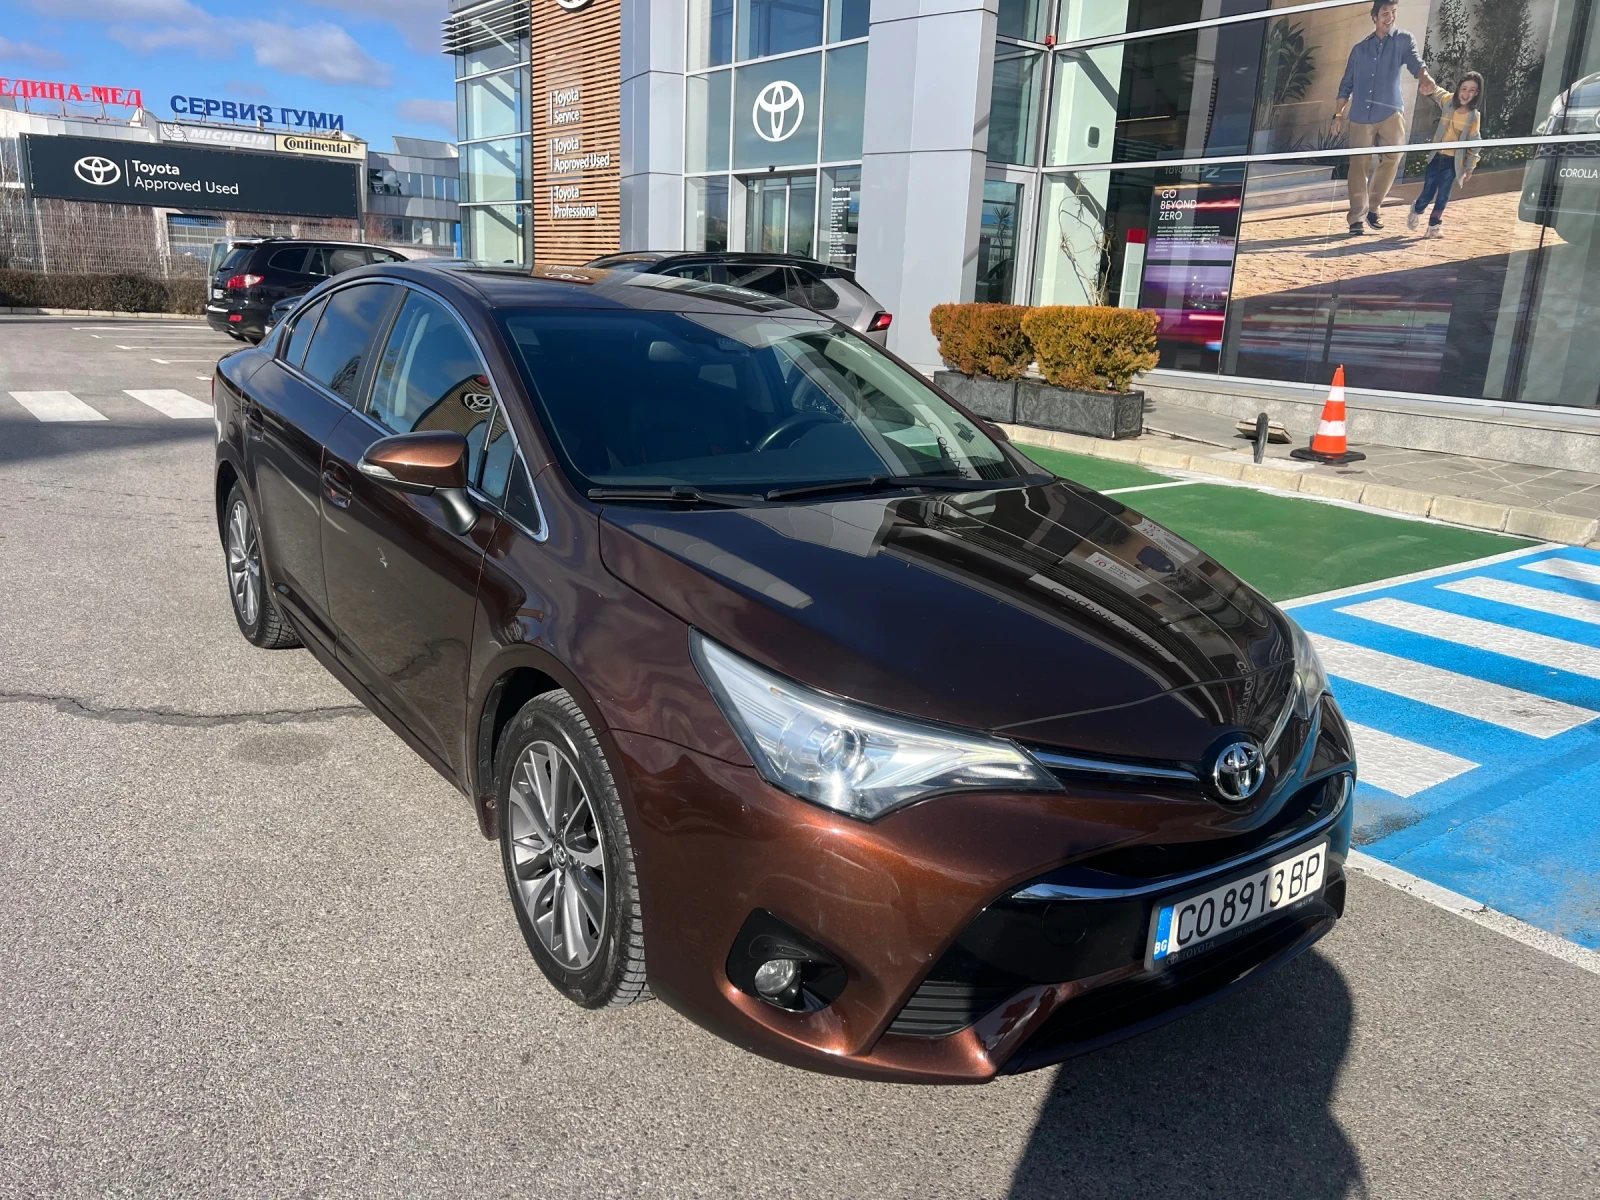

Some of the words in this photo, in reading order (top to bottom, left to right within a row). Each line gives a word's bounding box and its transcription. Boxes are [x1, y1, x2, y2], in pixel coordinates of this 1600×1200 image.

[555, 88, 579, 107] Toyota
[170, 95, 273, 123] СЕРВИЗ
[280, 107, 344, 130] ГУМИ
[554, 108, 580, 124] Service
[189, 128, 269, 146] MICHELIN
[283, 136, 352, 154] Continental
[555, 137, 579, 154] Toyota
[131, 160, 180, 176] Toyota
[555, 153, 590, 173] Approved
[590, 151, 610, 167] Used
[1560, 168, 1598, 178] COROLLA
[134, 176, 201, 192] Approved
[205, 181, 239, 195] Used
[555, 185, 580, 202] Toyota
[1161, 189, 1177, 199] GO
[554, 203, 598, 218] Professional
[1160, 200, 1197, 210] BEYOND
[1159, 211, 1183, 220] ZERO
[1154, 939, 1168, 955] BG
[1181, 940, 1215, 960] TOYOTA
